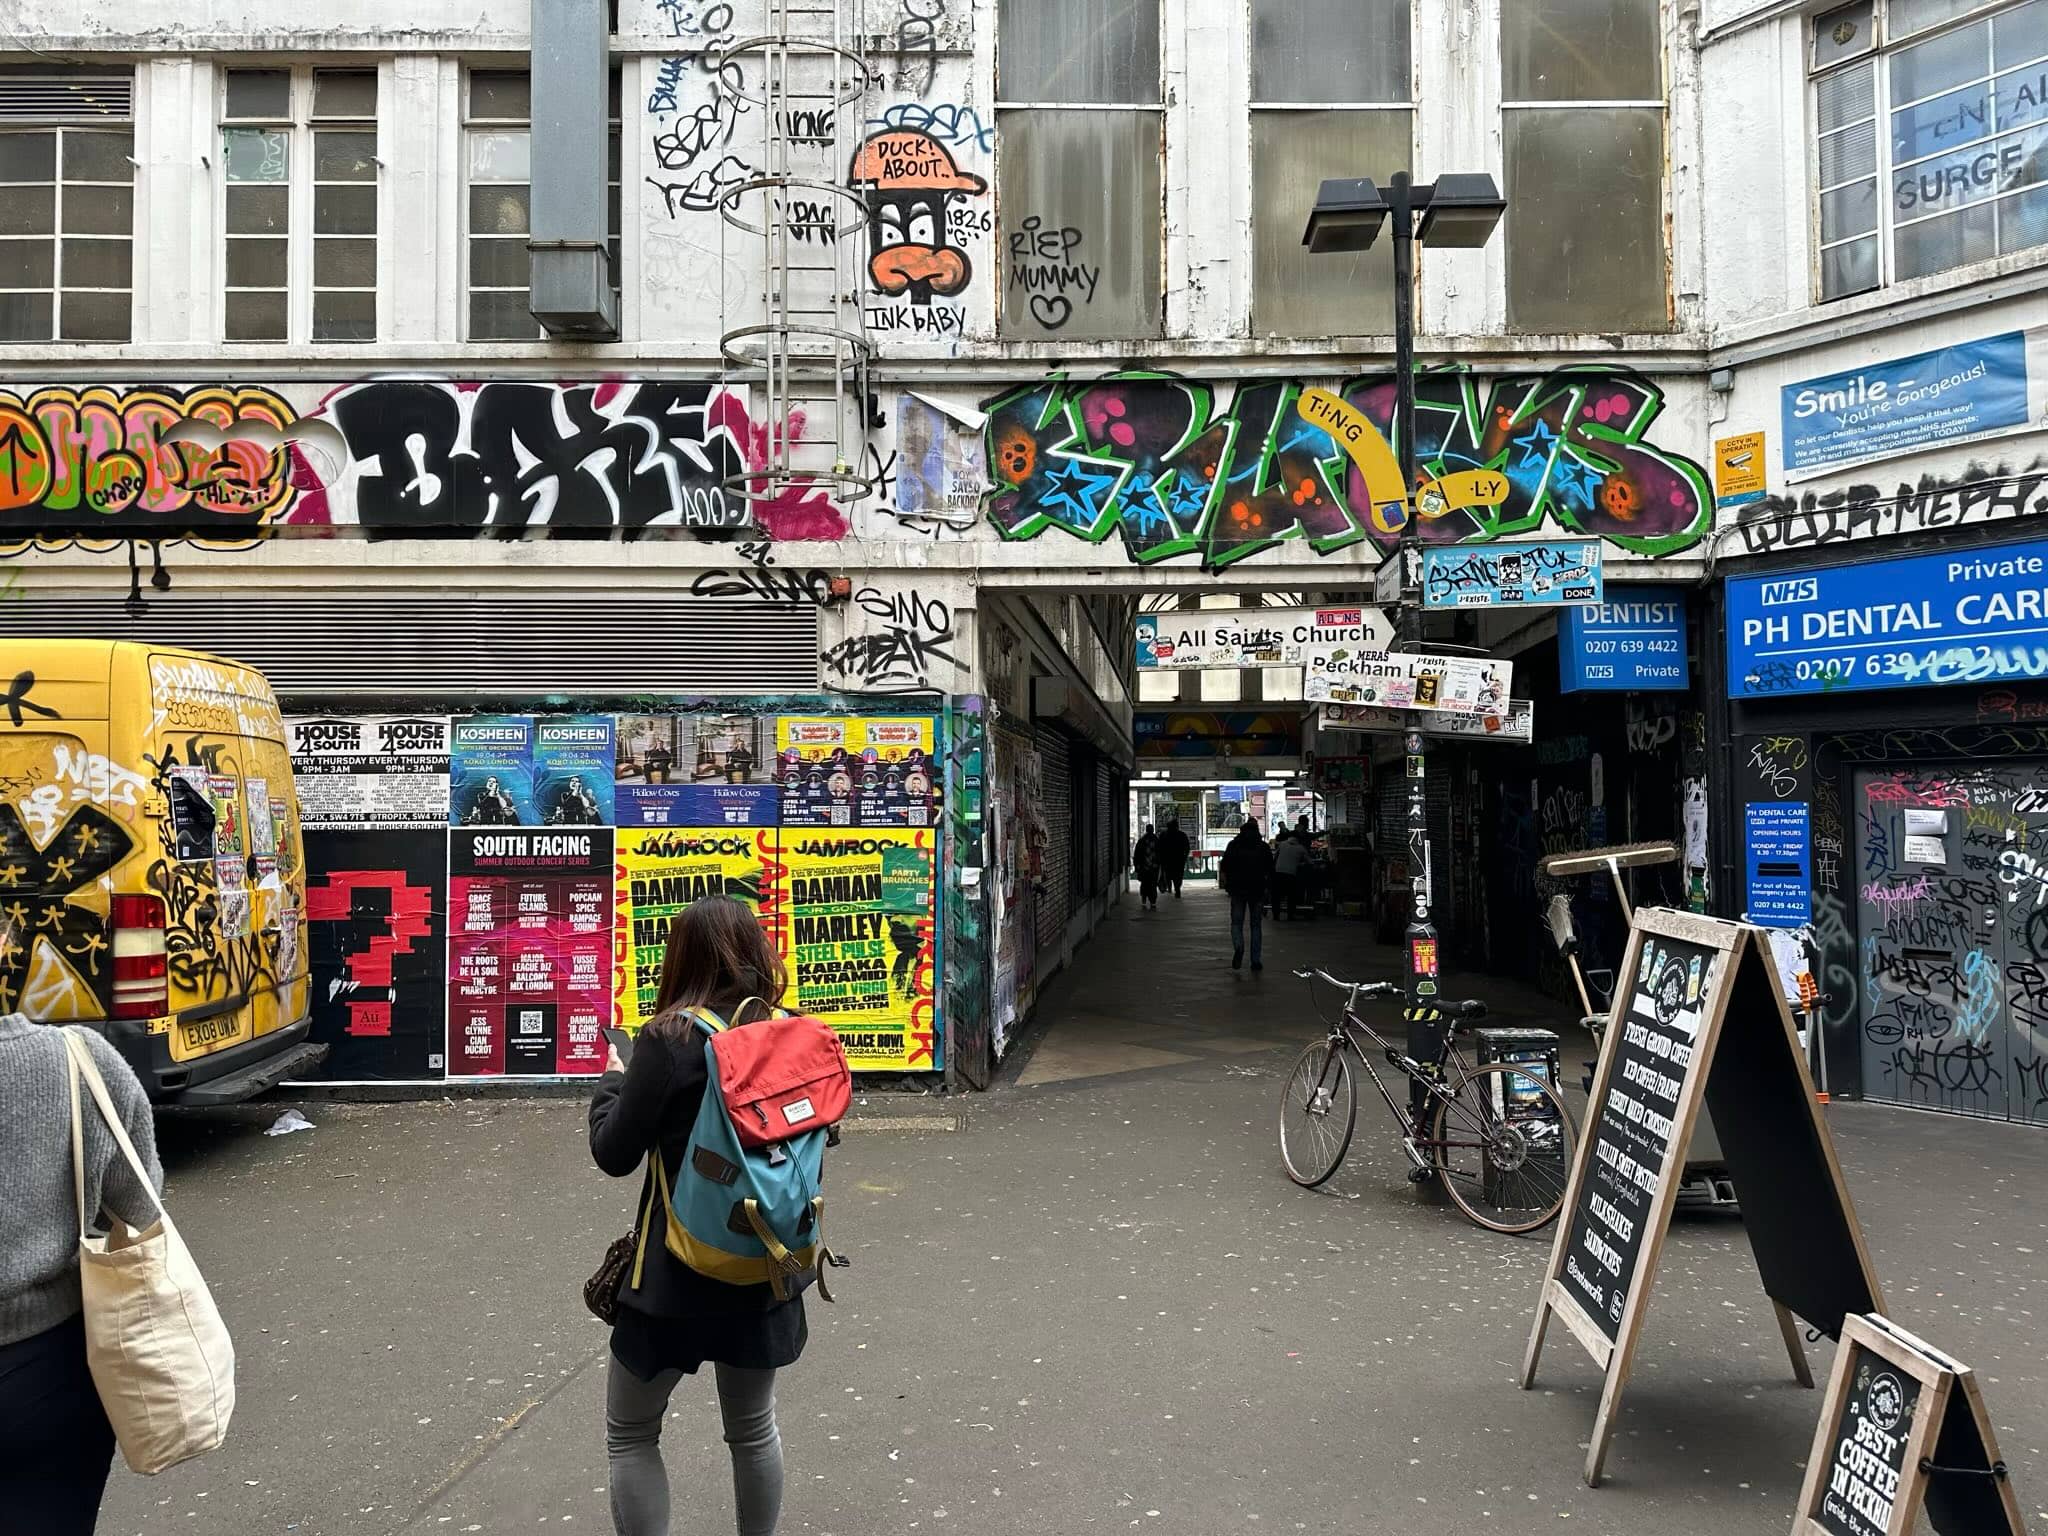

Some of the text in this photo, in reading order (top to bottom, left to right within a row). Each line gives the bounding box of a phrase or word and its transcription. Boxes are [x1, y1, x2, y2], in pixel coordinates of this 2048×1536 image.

[878, 139, 935, 159] DUCK!
[1009, 264, 1099, 303] MUMMY
[1793, 376, 1888, 418] Smile
[1836, 360, 1987, 428] You're Gorgeous!
[1794, 438, 1805, 446] So
[1806, 435, 1817, 445] let
[1818, 434, 1831, 442] our
[1833, 427, 1866, 439] Dentists
[1867, 422, 1885, 433] help
[1886, 419, 1902, 430] you
[1904, 414, 1924, 425] keep
[1934, 408, 1951, 418] that
[1953, 403, 1973, 414] way!
[1727, 439, 1744, 447] CCTV
[1794, 450, 1807, 459] We
[1809, 448, 1821, 456] are
[1823, 440, 1857, 453] currently
[1859, 431, 1900, 446] accepting
[1901, 427, 1919, 436] new
[1920, 422, 1940, 433] NHS
[1795, 457, 1817, 466] come
[1827, 451, 1842, 461] and
[1844, 446, 1866, 457] make
[1879, 433, 1931, 451] appointment
[1934, 425, 1968, 438] TODAY!
[1721, 442, 1759, 454] OPERATION
[1948, 556, 2042, 584] Private
[1565, 589, 1593, 598] DONE
[1764, 580, 1816, 603] NHS
[1584, 604, 1677, 624] DENTIST
[1743, 616, 1789, 646] PH
[1803, 601, 1941, 641] DENTAL
[1177, 630, 1206, 648] All
[1293, 624, 1375, 644] Church
[1586, 640, 1678, 653] 0207 639 4422
[1357, 650, 1389, 662] MERAS
[1586, 665, 1680, 678] NHS Private
[1796, 656, 1856, 681] 0207
[1865, 652, 1912, 676] 639
[295, 726, 360, 740] HOUSE
[379, 725, 444, 740] HOUSE
[460, 729, 523, 740] KOSHEEN
[543, 729, 606, 740] KOSHEEN
[314, 740, 360, 750] SOUTH
[397, 739, 443, 750] SOUTH
[318, 756, 366, 765] THURSDAY
[369, 756, 450, 765] EVERY THURSDAY
[302, 765, 350, 773] 9PM 3AM
[385, 765, 433, 773] 9PM 3AM
[632, 788, 680, 797] Hollow Coves
[412, 812, 448, 821] SW4 7TS
[473, 836, 591, 856] SOUTH FACING
[632, 836, 752, 858] JAMROCK
[474, 857, 590, 866] SUMMER OUTDOOR CONCERT SERIES
[891, 869, 920, 877] PARTY
[882, 876, 929, 884] BRUNCHES
[631, 874, 724, 907] DAMIAN
[792, 874, 882, 906] DAMIAN
[468, 894, 492, 903] GRACE
[520, 893, 547, 902] FUTURE
[569, 893, 603, 902] POPCAAN
[518, 903, 548, 912] ISLANDS
[575, 903, 596, 912] SPICE
[569, 913, 602, 923] RAMPAGE
[464, 921, 495, 931] MURPHY
[573, 922, 597, 932] SOUND
[794, 913, 889, 945] MARLEY
[796, 940, 886, 964] STEEL PULSE
[461, 956, 499, 966] THE ROOTS
[521, 953, 545, 963] MAJOR
[572, 955, 598, 965] YUSSEF
[460, 966, 500, 976] DE LA SOUL
[512, 963, 539, 972] LEAGUE
[574, 964, 596, 973] DAYES
[797, 958, 887, 975] KABAKA
[472, 977, 486, 986] THE
[516, 973, 549, 982] BALCONY
[798, 970, 888, 986] PYRAMID
[461, 986, 497, 995] PHARCYDE
[510, 981, 554, 991] MIX LONDON
[798, 980, 888, 1000] ROMAIN VIRGO
[799, 994, 889, 1007] CHANNEL ONE
[842, 1001, 889, 1011] SYSTEM
[471, 1017, 487, 1026] JESS
[569, 1016, 598, 1025] DAMIAN
[188, 1021, 216, 1045] EX08
[465, 1026, 493, 1035] GLYNNE
[1624, 1021, 1649, 1049] FRESH
[469, 1036, 488, 1045] CIAN
[569, 1033, 598, 1043] MARLEY
[877, 1033, 905, 1047] BOWL
[465, 1045, 493, 1055] DUCROT
[1589, 1191, 1634, 1243] MILKSHAKES
[1583, 1227, 1623, 1278] SANDWICHES
[1854, 1416, 1897, 1462] BEST
[1839, 1437, 1900, 1501] COFFEE
[1830, 1463, 1849, 1499] IN
